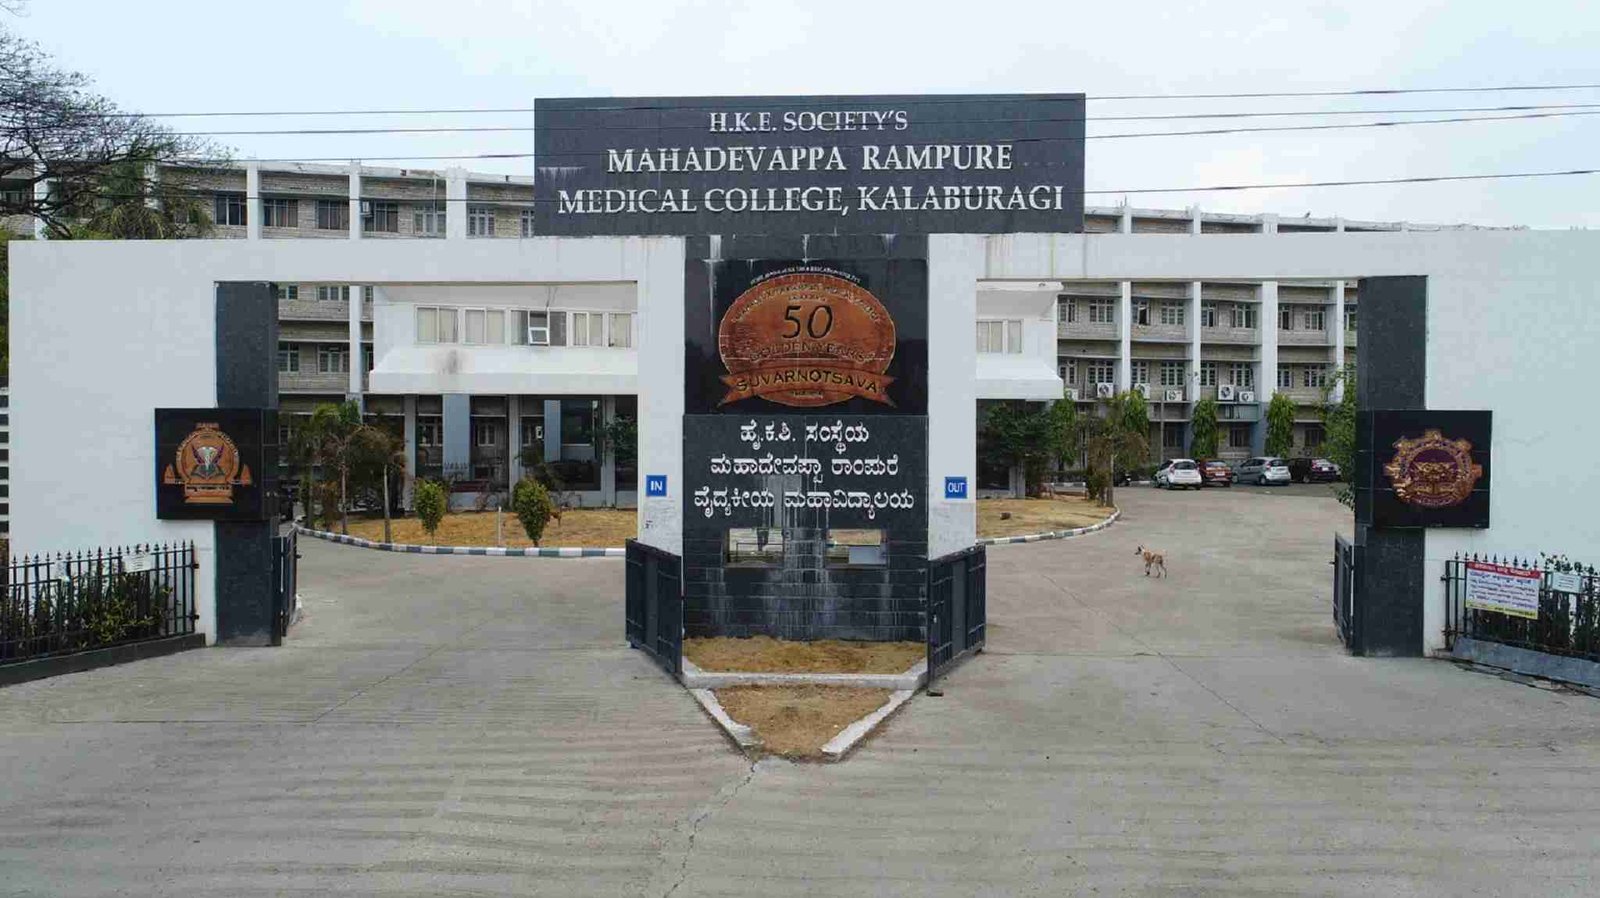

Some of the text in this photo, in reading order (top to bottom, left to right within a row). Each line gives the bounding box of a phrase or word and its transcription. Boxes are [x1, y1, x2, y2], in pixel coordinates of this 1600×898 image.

[709, 111, 908, 132] H.K.E. SOCIETY'S
[607, 144, 1013, 172] MAHADEVAPPA RAMPURE
[558, 185, 1064, 216] MEDICAL COLLEGE, KALABURAGI
[782, 305, 833, 339] 50
[736, 369, 877, 393] SUVARNOTSAVA
[806, 420, 869, 454] ಸಂಸ್ಥೆಯ
[831, 454, 899, 475] ರಾಂಪುರೆ
[650, 480, 663, 491] IN
[947, 482, 965, 493] OUT
[694, 486, 914, 519] ವೈದ್ಯಕೀಯ ಮಹಾವಿದ್ಯಾಲಯ
